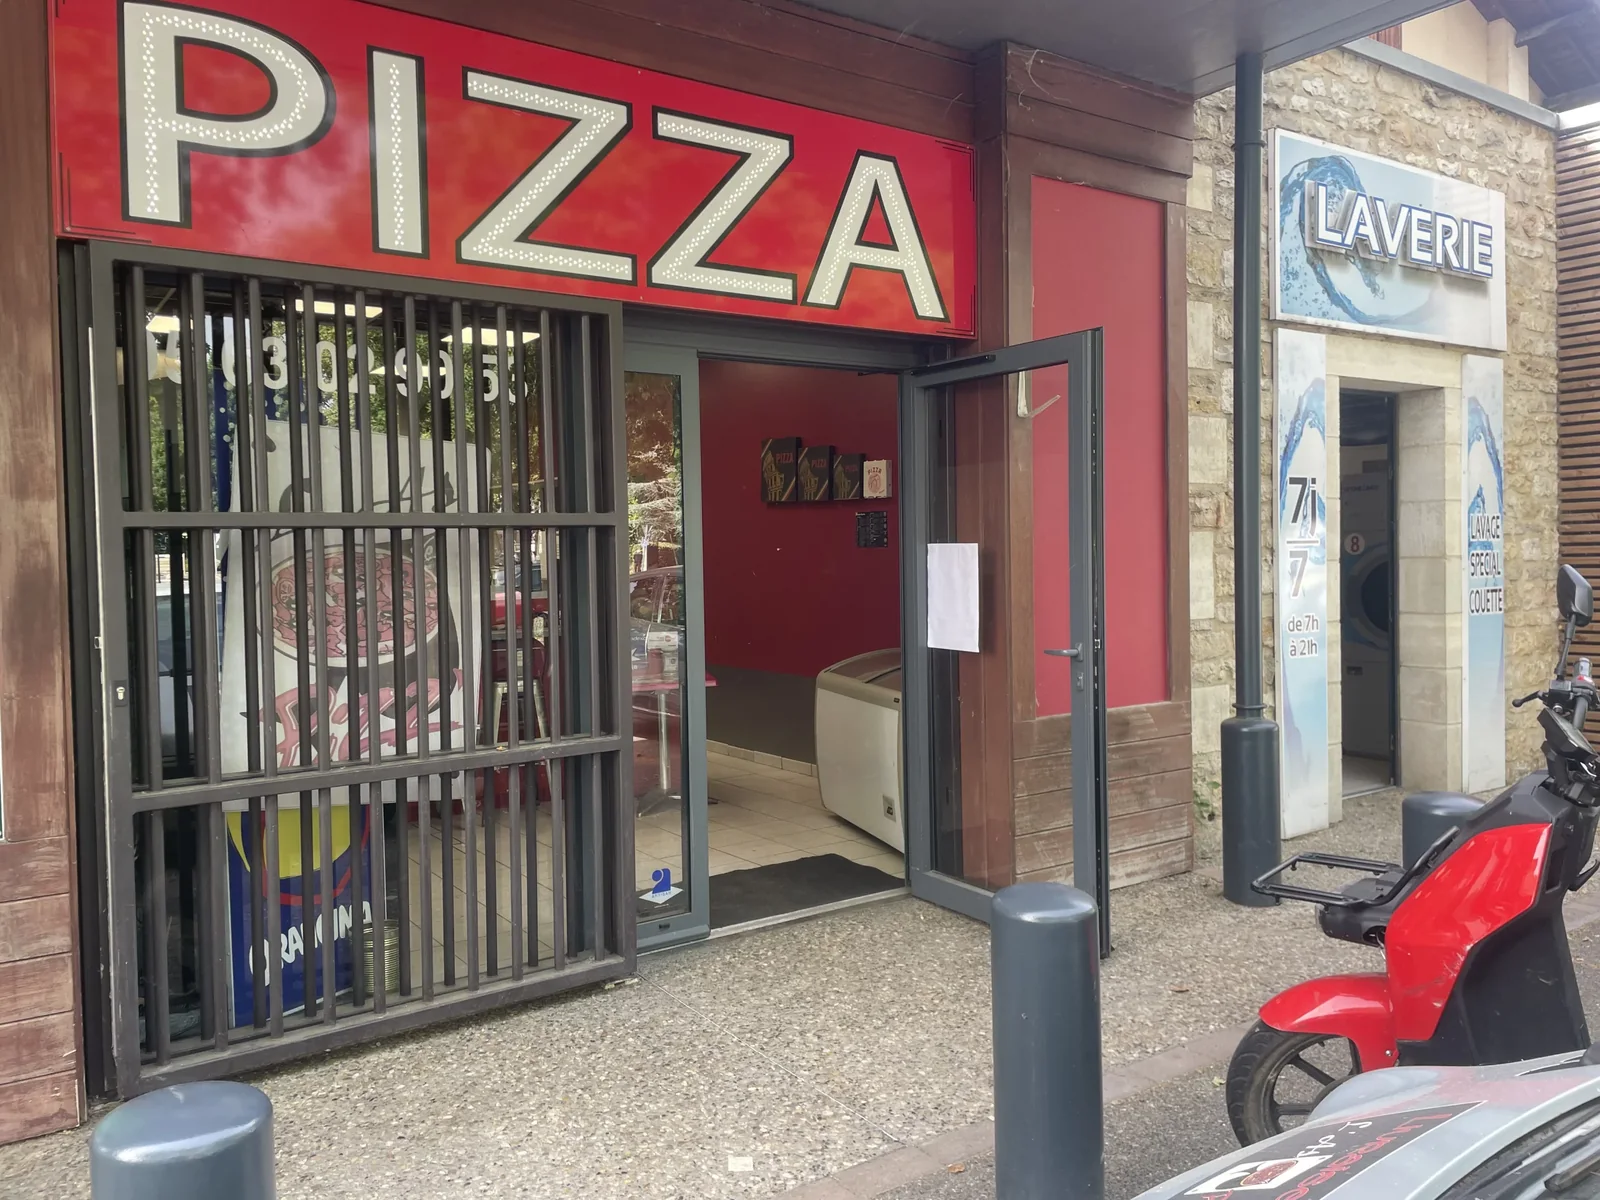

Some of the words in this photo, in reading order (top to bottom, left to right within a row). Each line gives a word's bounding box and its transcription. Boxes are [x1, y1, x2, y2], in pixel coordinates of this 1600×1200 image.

[122, 1, 950, 321] PIZZA
[1312, 181, 1493, 279] LAVERIE
[316, 341, 377, 394] 02
[776, 452, 794, 464] PIZZA
[867, 466, 882, 475] PIZZA
[1288, 476, 1317, 537] 7j
[1470, 515, 1500, 540] LAVAGE
[1350, 535, 1360, 553] 8
[1288, 550, 1309, 598] 7
[1470, 552, 1501, 577] SPECIAL
[1469, 588, 1503, 614] COUETTE
[1287, 614, 1303, 632] de
[1304, 614, 1319, 631] 7h
[1289, 639, 1297, 657] à
[1299, 639, 1318, 656] 21h
